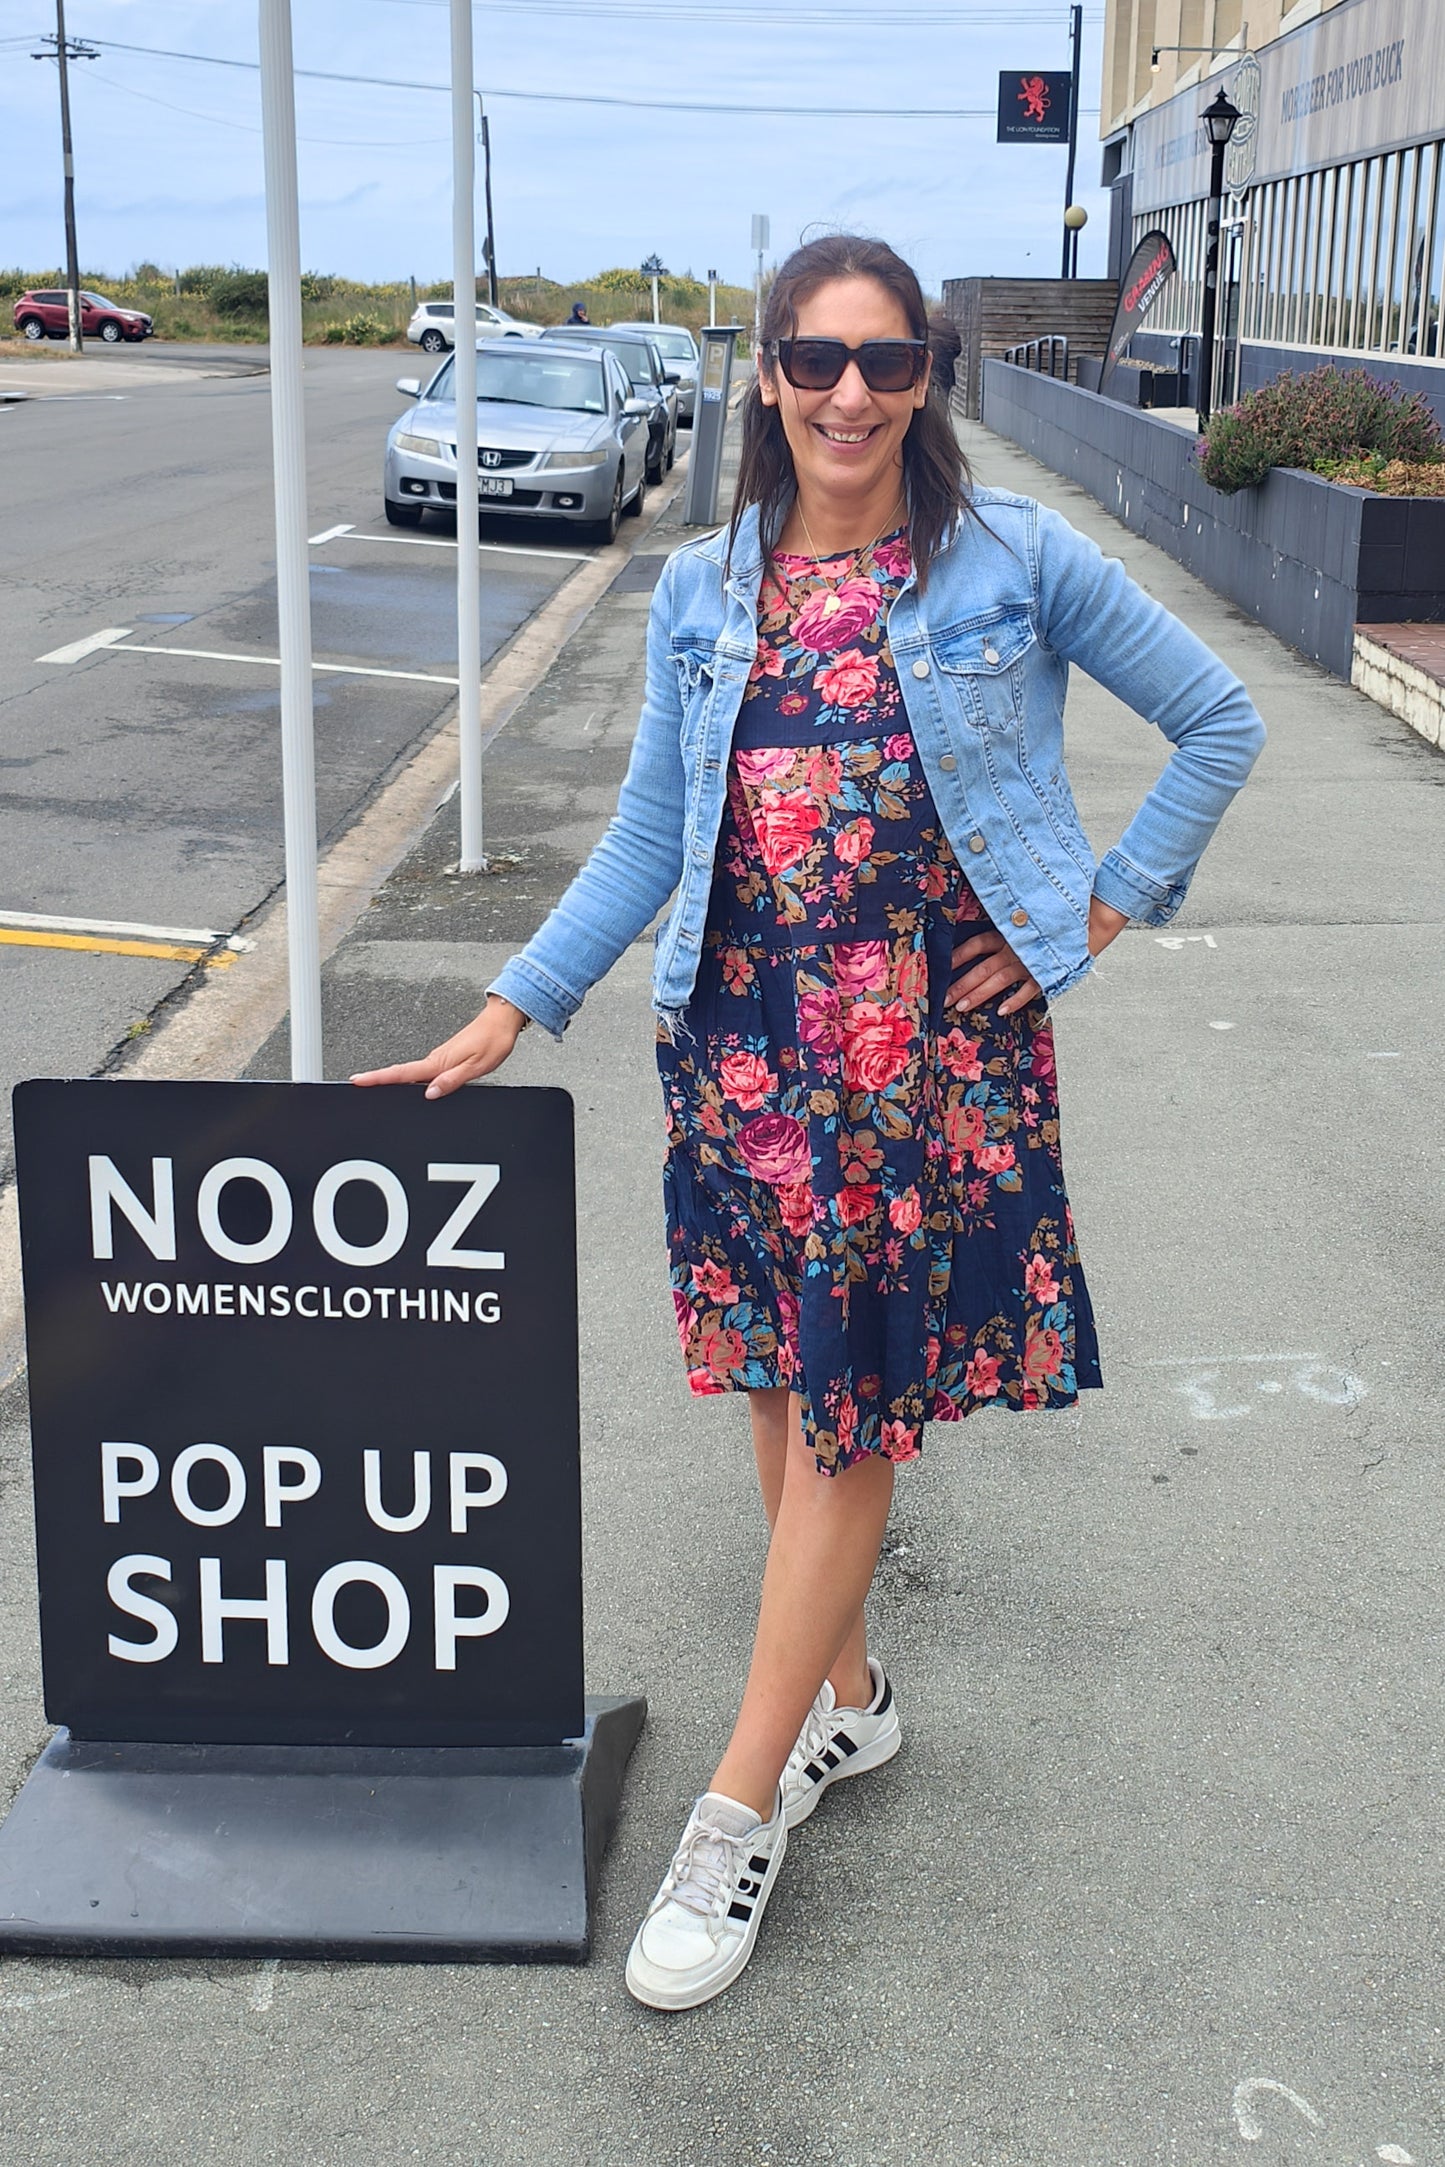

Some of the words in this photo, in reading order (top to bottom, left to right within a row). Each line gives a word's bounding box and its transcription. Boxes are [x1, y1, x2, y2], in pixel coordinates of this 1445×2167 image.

[1326, 66, 1344, 108] FOR
[1345, 54, 1373, 100] YOUR
[1373, 39, 1404, 90] BUCK
[1123, 242, 1169, 313] GAMING
[1137, 269, 1167, 313] VENUE
[89, 1156, 505, 1270] NOOZ
[101, 1281, 501, 1323] WOMENSCLOTHING
[101, 1442, 322, 1528] POP
[363, 1449, 508, 1533] UP
[107, 1554, 510, 1670] SHOP
